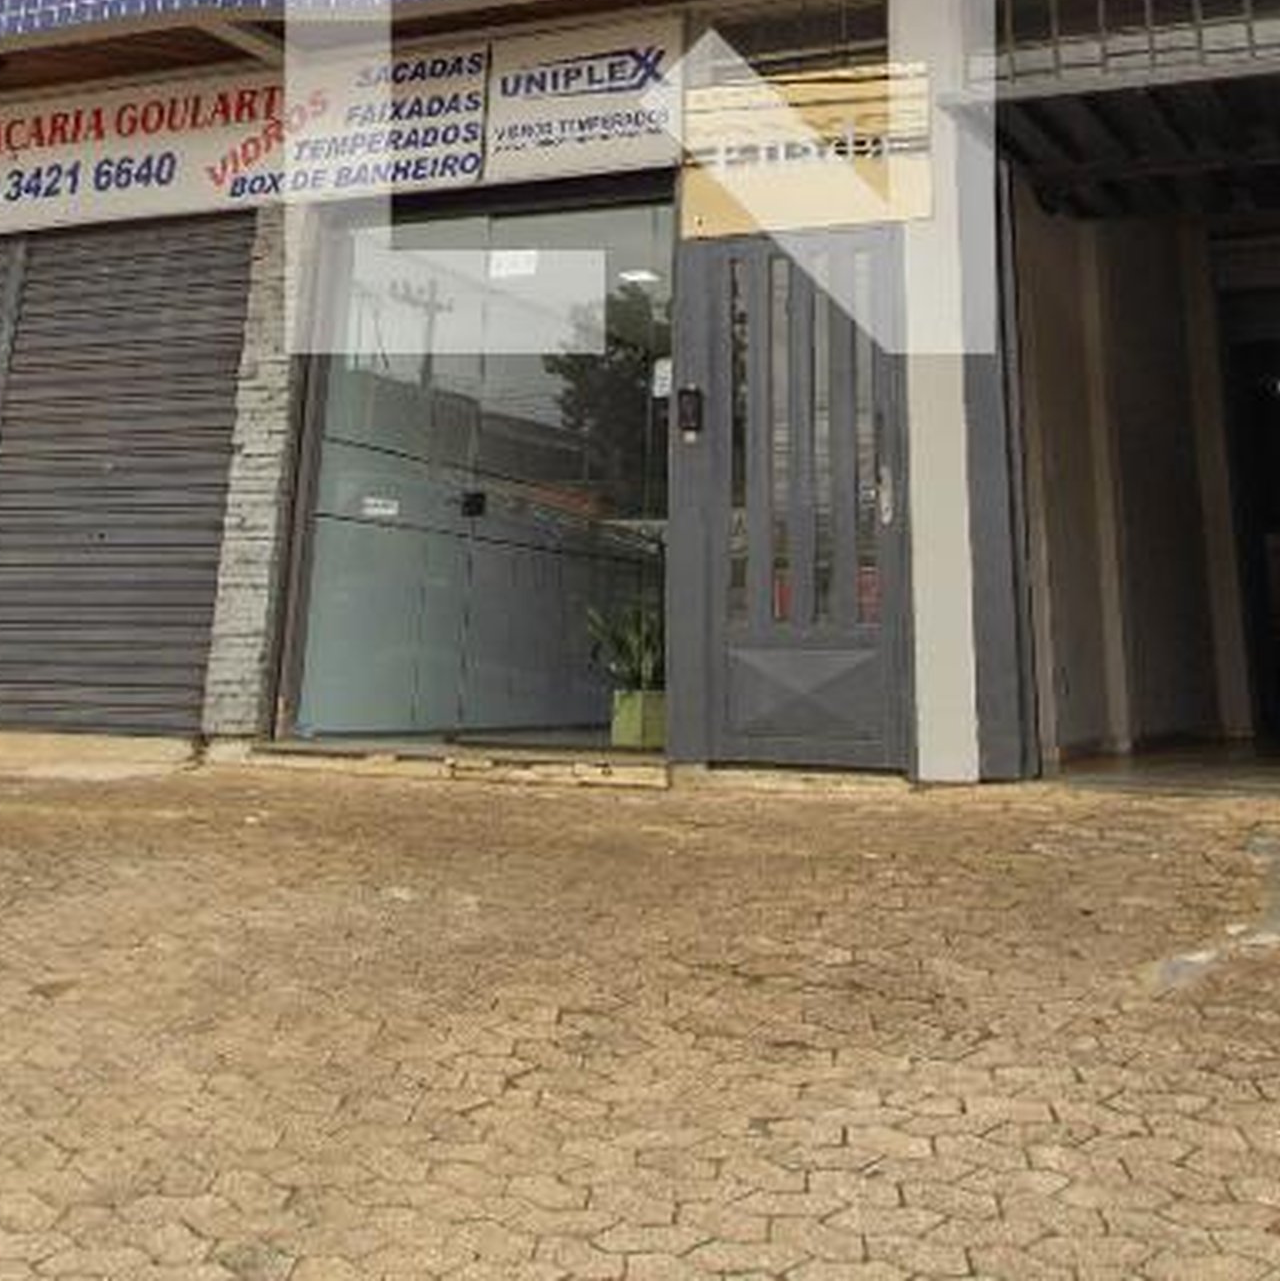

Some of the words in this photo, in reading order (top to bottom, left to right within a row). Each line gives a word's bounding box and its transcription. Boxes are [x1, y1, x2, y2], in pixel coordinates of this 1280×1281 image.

[355, 53, 484, 89] SACADAS
[500, 46, 666, 96] UNIPLEX
[114, 86, 285, 138] GOULART
[345, 91, 483, 128] FAIXADAS
[206, 88, 328, 187] VIDROS
[294, 121, 481, 162] TEMPERADOS
[4, 162, 81, 203] 3421
[93, 151, 177, 194] 6640
[229, 170, 285, 198] BOX
[290, 169, 329, 191] DE
[334, 152, 482, 189] BANHEIRO
